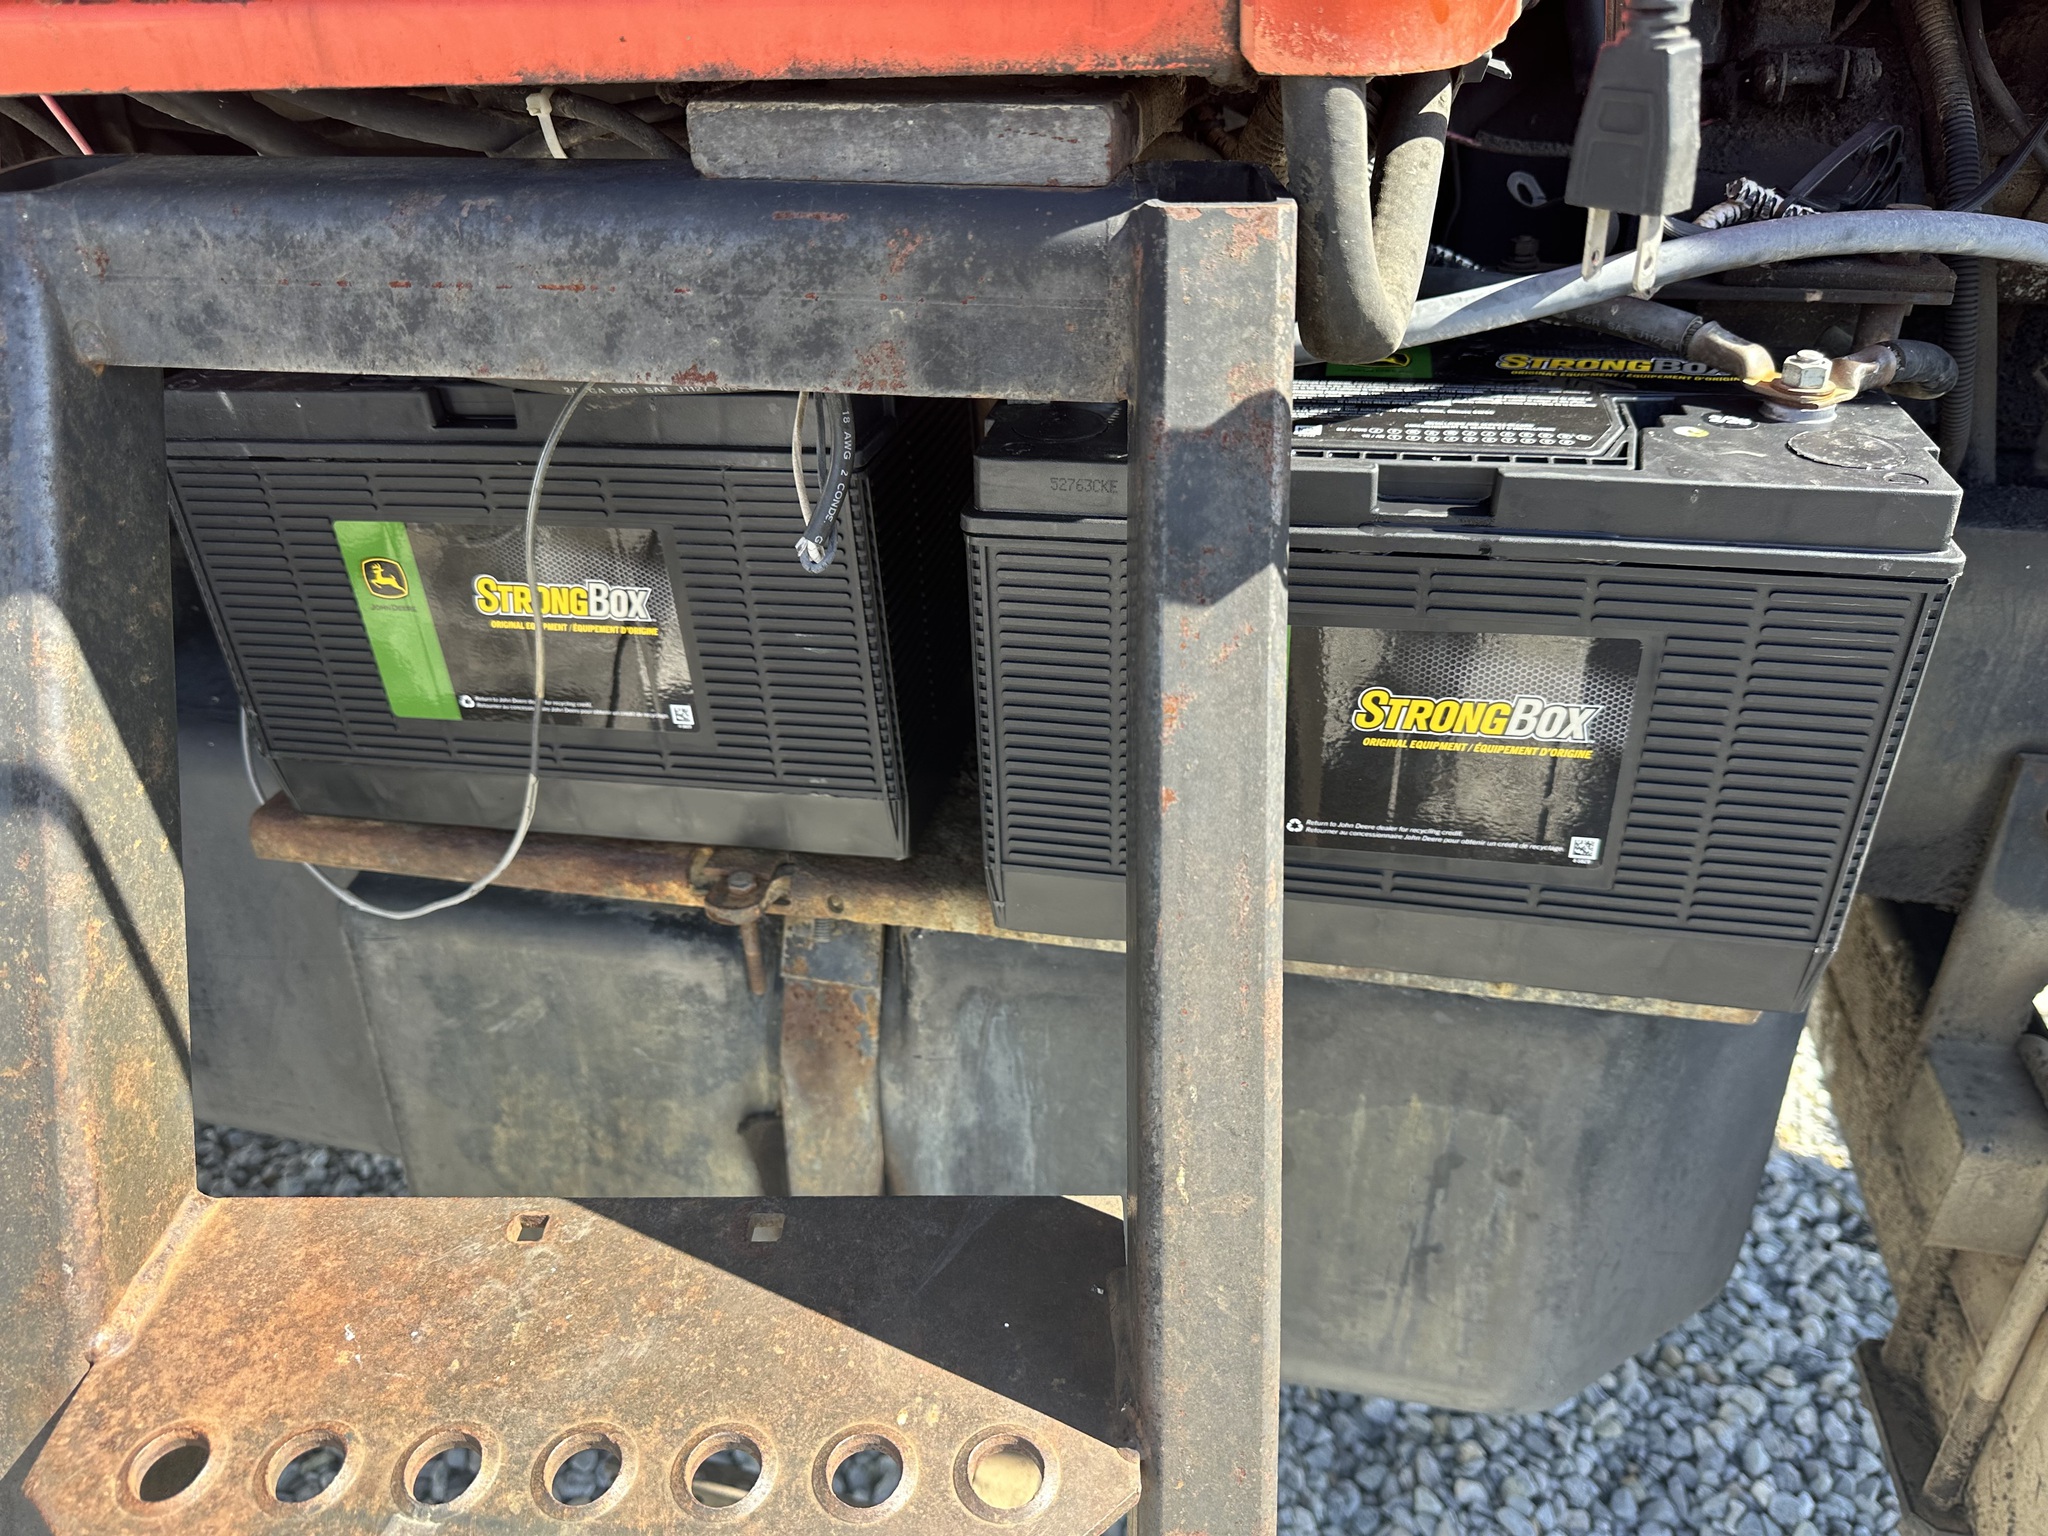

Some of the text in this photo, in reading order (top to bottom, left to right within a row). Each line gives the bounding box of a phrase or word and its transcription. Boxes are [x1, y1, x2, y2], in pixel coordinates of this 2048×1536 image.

[1575, 314, 1600, 328] SGR
[1496, 354, 1731, 376] STRONGBO
[1510, 369, 1557, 377] ORIGINAL
[1559, 371, 1620, 379] EQUIPMENT
[1694, 375, 1741, 383] D'ORIGIN
[612, 386, 637, 395] SGR
[644, 386, 671, 394] SAE
[677, 385, 708, 394] J1127
[842, 410, 850, 424] 18
[843, 431, 852, 460] AWG
[840, 469, 849, 477] 2
[823, 483, 846, 523] CONDS.
[490, 620, 525, 630] ORIGINAL
[525, 621, 568, 632] EQPMENT
[572, 622, 619, 634] ÉQUIPEMENT
[620, 625, 659, 637] D'ORIGINE
[1362, 737, 1408, 749] ORIGINAL
[1409, 739, 1467, 752] EQUIPMENT
[1474, 742, 1540, 756] ÉQUIPEMENT
[1539, 746, 1594, 760] D'ORIGINE
[1305, 819, 1329, 827] Return
[1337, 821, 1354, 829] John
[1355, 822, 1376, 831] Deere
[1376, 823, 1398, 832] dealer
[1399, 825, 1409, 833] for
[1409, 827, 1441, 836] recycling
[1305, 826, 1338, 835] Retourner
[1348, 829, 1403, 840] concessionnaire
[1403, 833, 1421, 841] John
[1421, 835, 1443, 843] Deere
[1442, 837, 1460, 845] pour
[1460, 838, 1487, 846] obtenir
